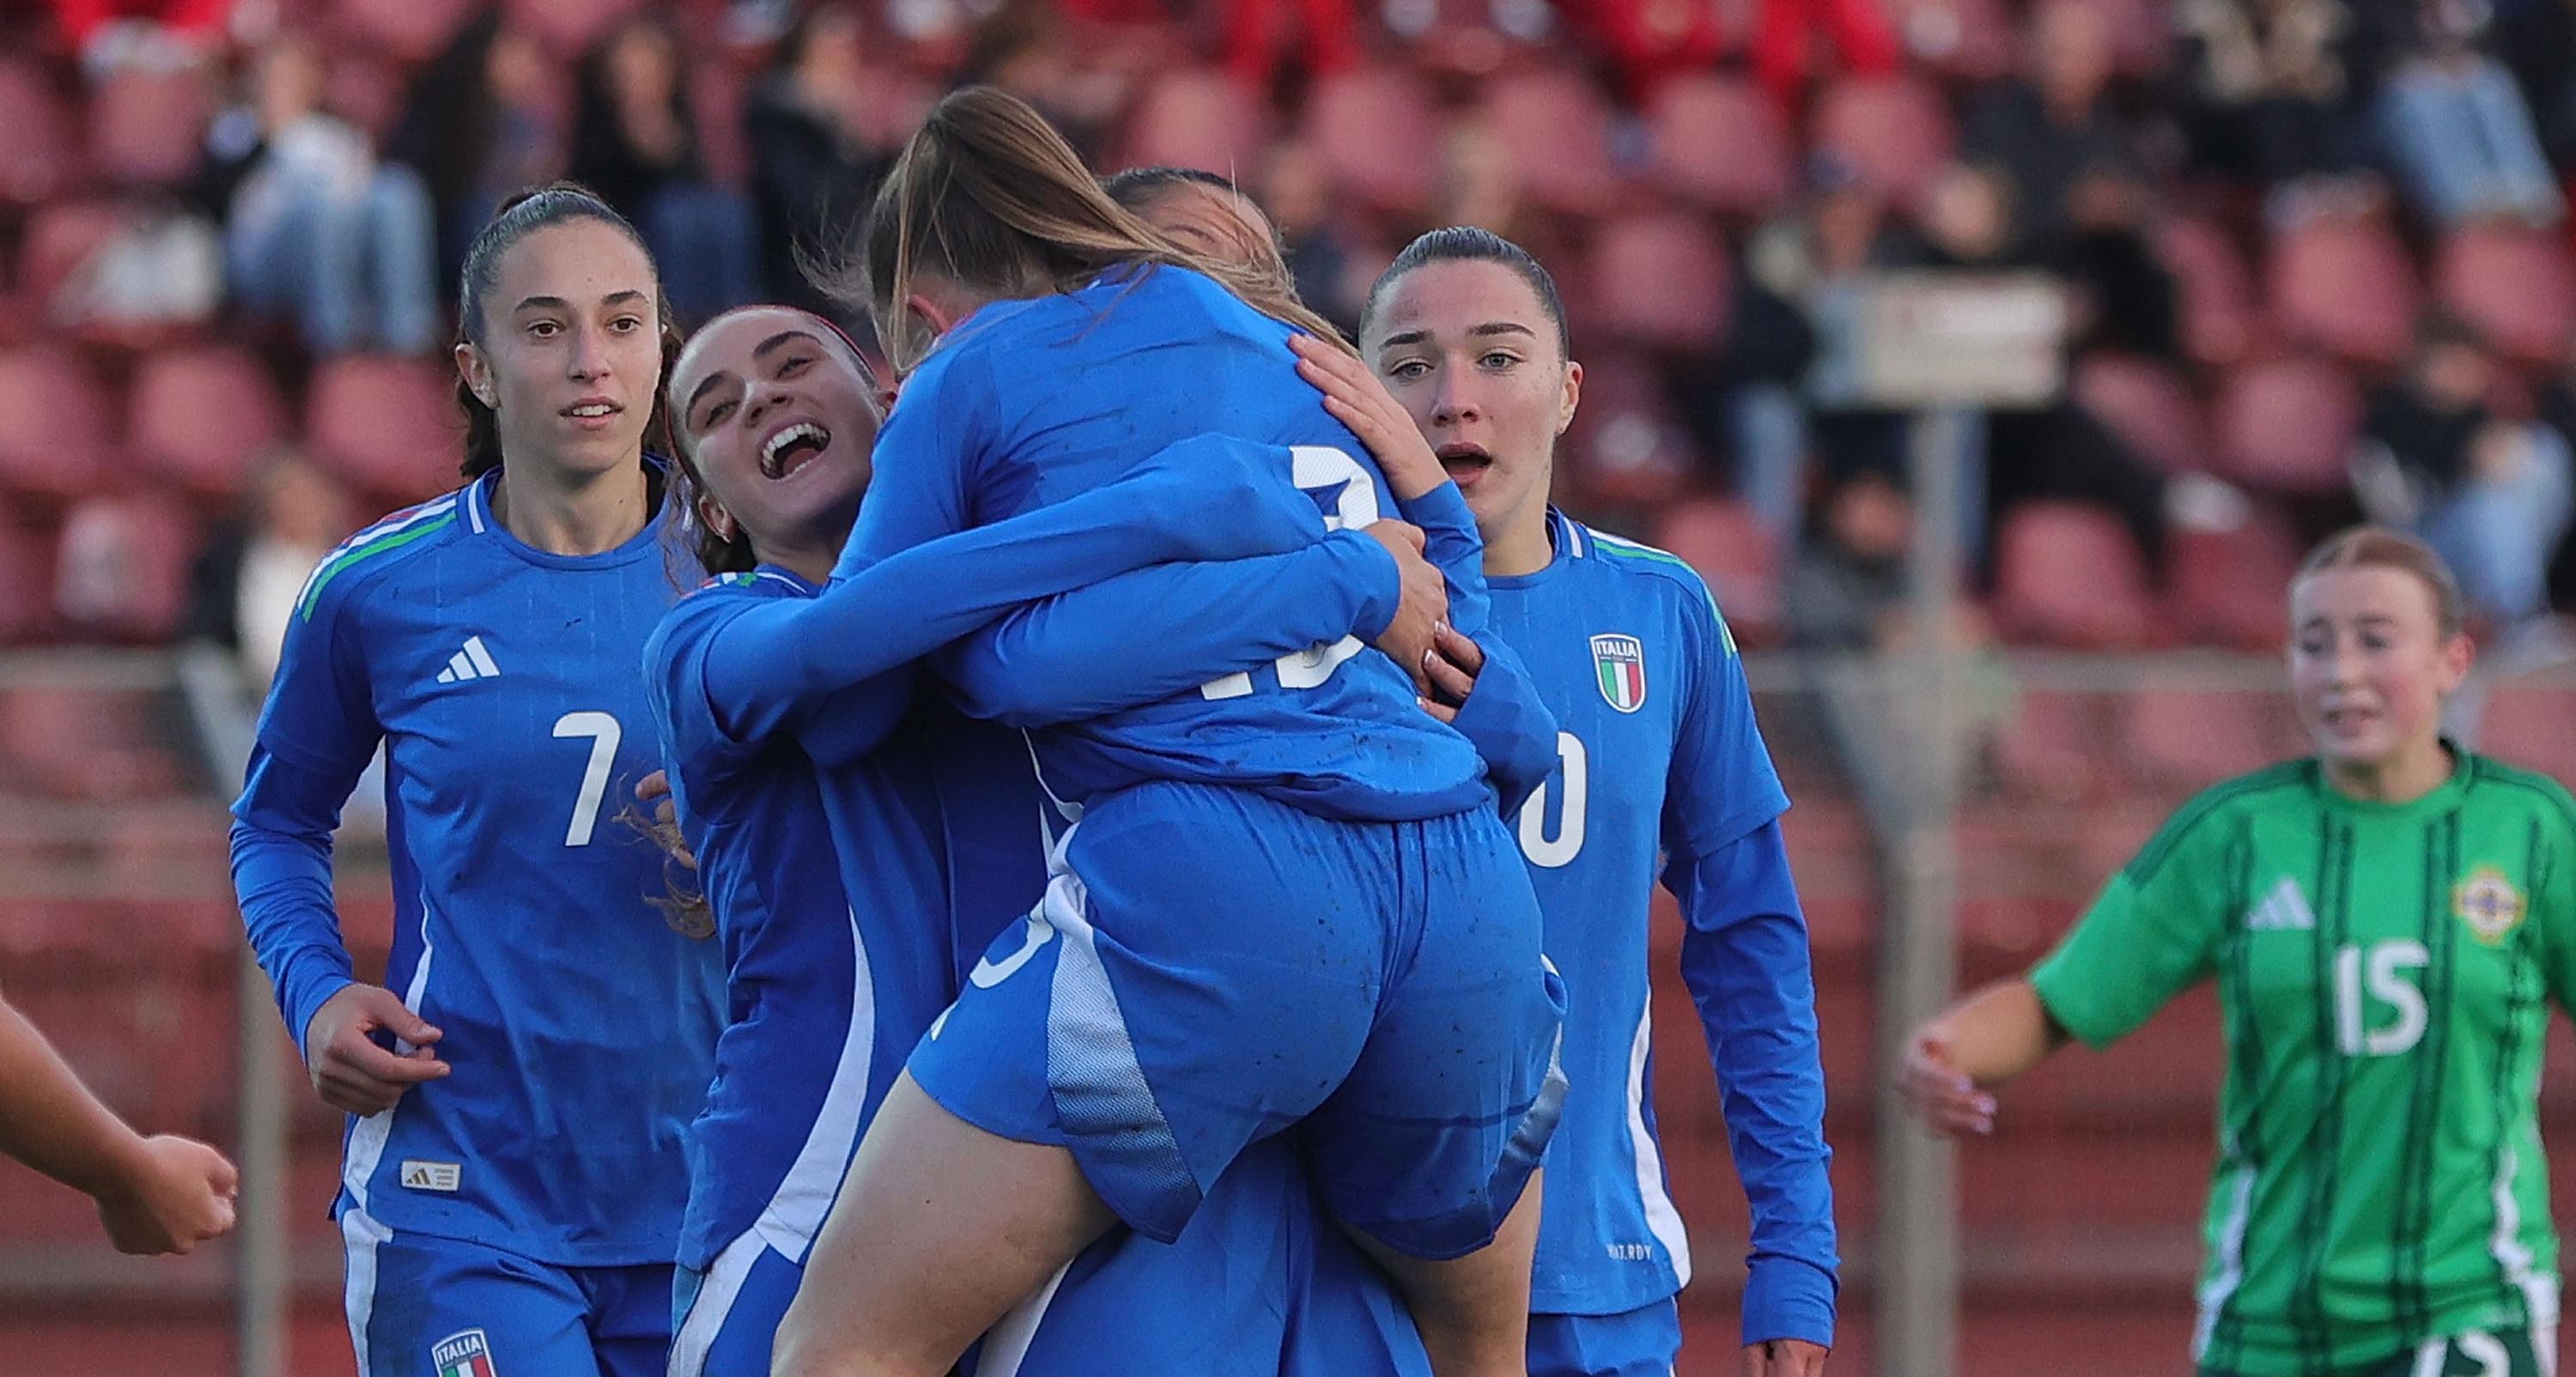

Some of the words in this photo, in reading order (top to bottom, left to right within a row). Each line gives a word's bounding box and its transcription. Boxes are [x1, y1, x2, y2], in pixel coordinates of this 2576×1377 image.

[1596, 640, 1637, 657] ITALIA
[553, 712, 621, 846] 7
[2336, 940, 2429, 1056] 15
[436, 1335, 482, 1365] ITALIA
